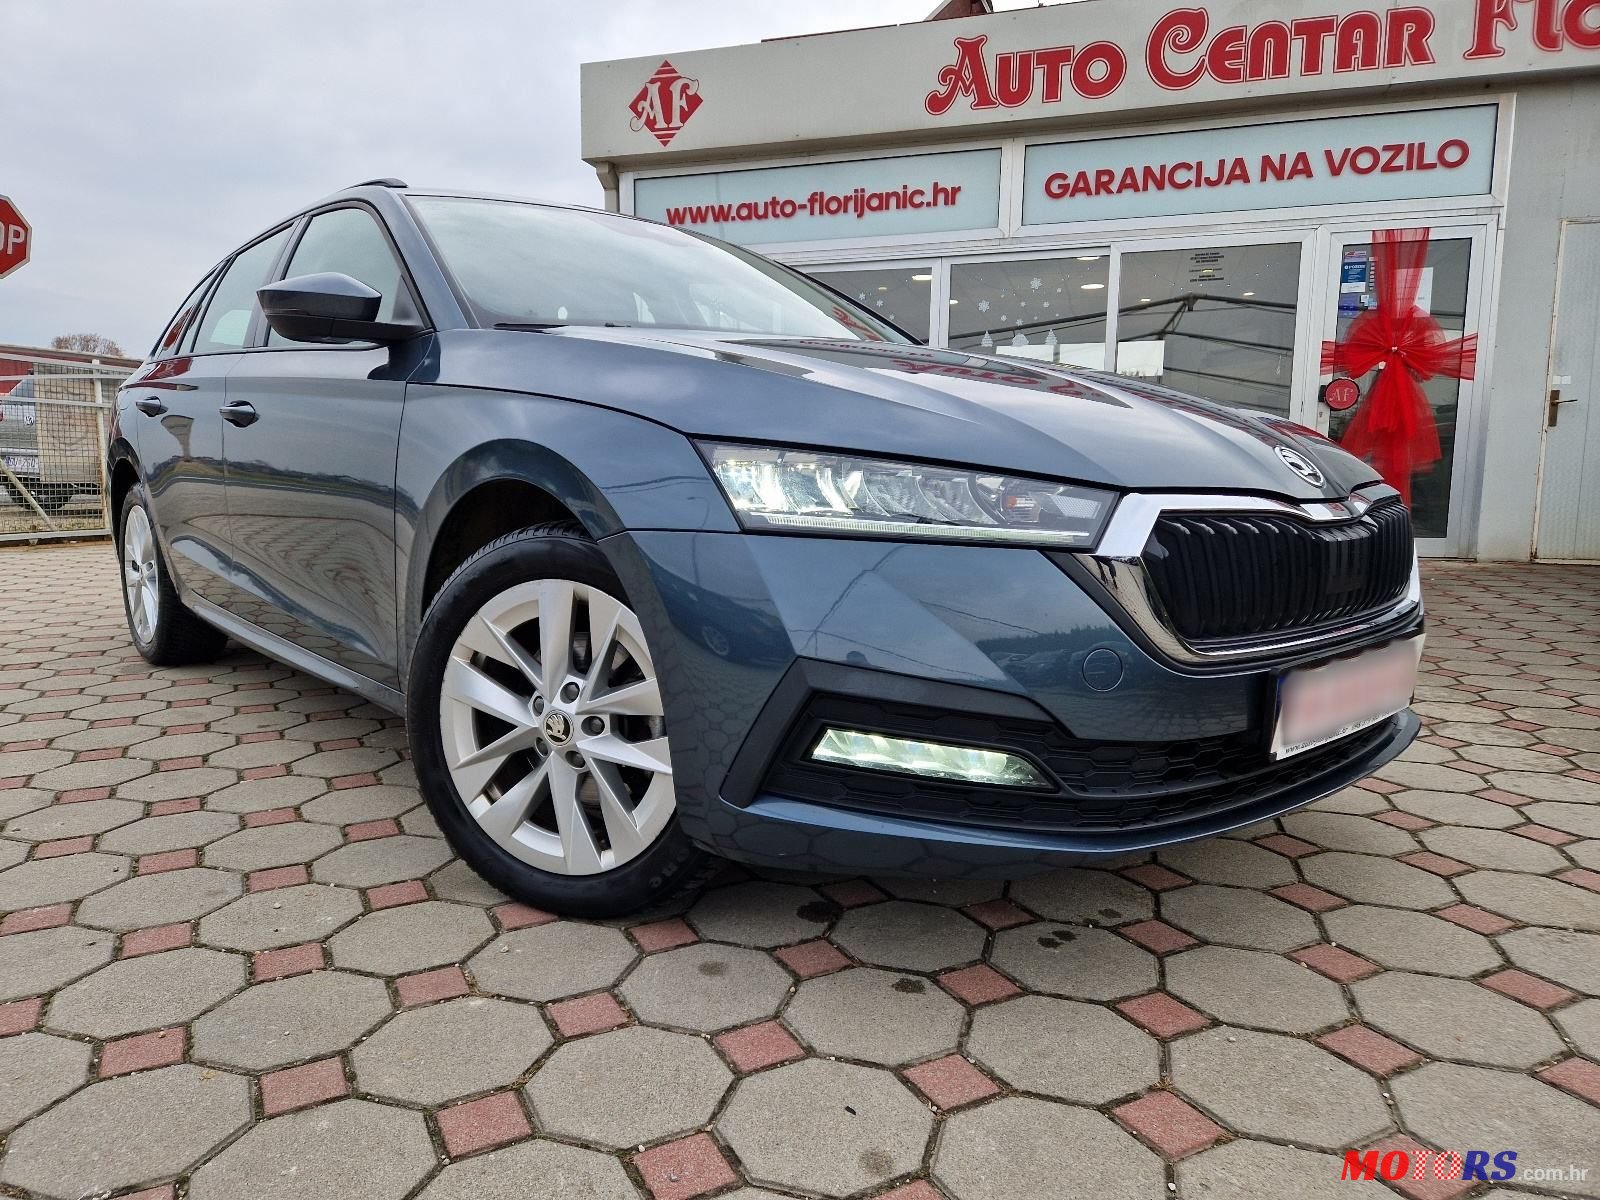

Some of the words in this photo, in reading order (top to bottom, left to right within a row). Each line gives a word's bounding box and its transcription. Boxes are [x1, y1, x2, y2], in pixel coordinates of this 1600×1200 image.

[1044, 157, 1251, 200] GARANCIJA
[1259, 151, 1314, 182] NA
[1323, 138, 1470, 177] VOZILO
[665, 182, 962, 226] www.auto-florijanic.hr
